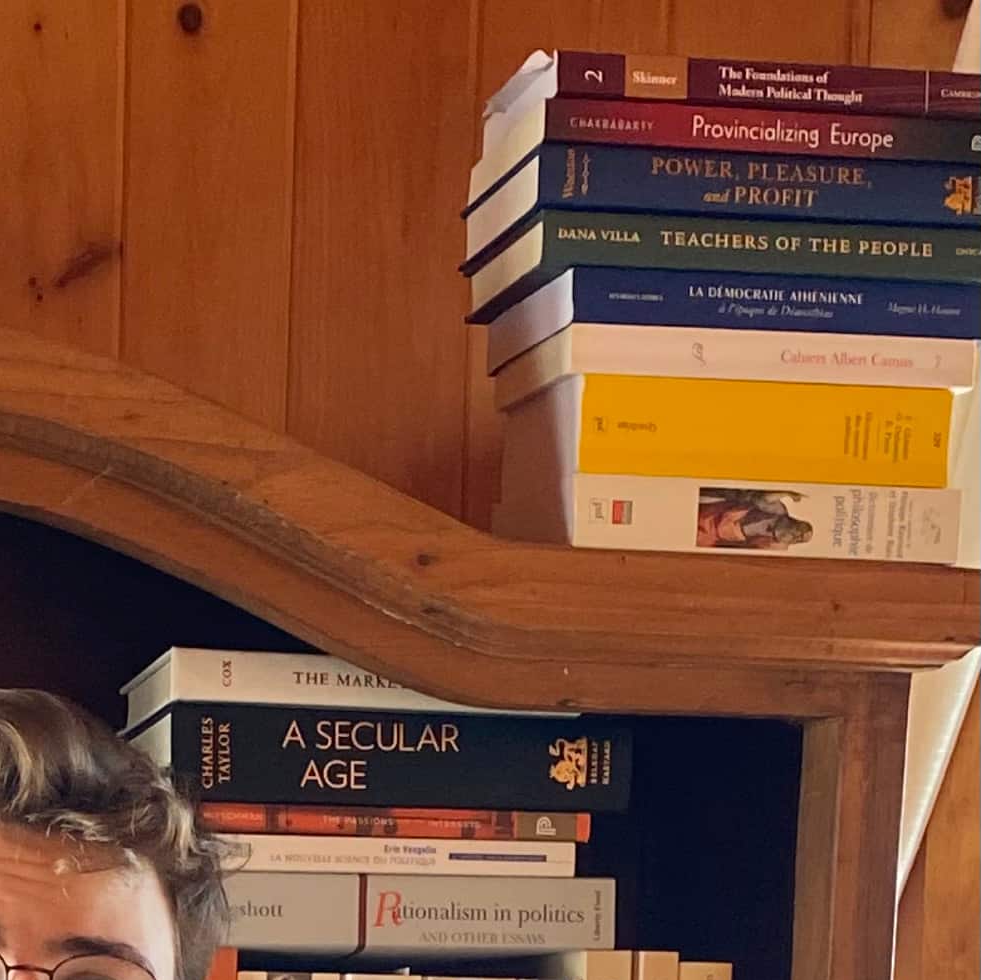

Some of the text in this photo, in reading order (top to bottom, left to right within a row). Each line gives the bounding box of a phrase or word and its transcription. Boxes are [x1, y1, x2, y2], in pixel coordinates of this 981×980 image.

[584, 69, 604, 84] 2
[632, 71, 679, 87] Skinner
[718, 66, 829, 83] The Foundations of
[719, 85, 862, 106] Modern Political Thought
[570, 117, 654, 131] CHAKRABARTY
[693, 114, 895, 153] Provincializing Europe
[651, 156, 872, 189] POWER, PLEASURE,
[703, 184, 820, 209] and PROFIT
[558, 228, 641, 243] DANA VILLA
[660, 231, 934, 258] TEACHERS OF THE PEOPLE
[689, 286, 704, 297] LA
[221, 660, 232, 688] COX
[293, 670, 330, 686] THE
[281, 719, 461, 753] A SECULAR
[201, 716, 213, 790] CHARLES
[217, 722, 231, 784] TAYLOR
[299, 759, 368, 790] AGE
[372, 890, 586, 929] Rationalism in politics
[421, 930, 548, 947] AND OTHER ESSAYS
